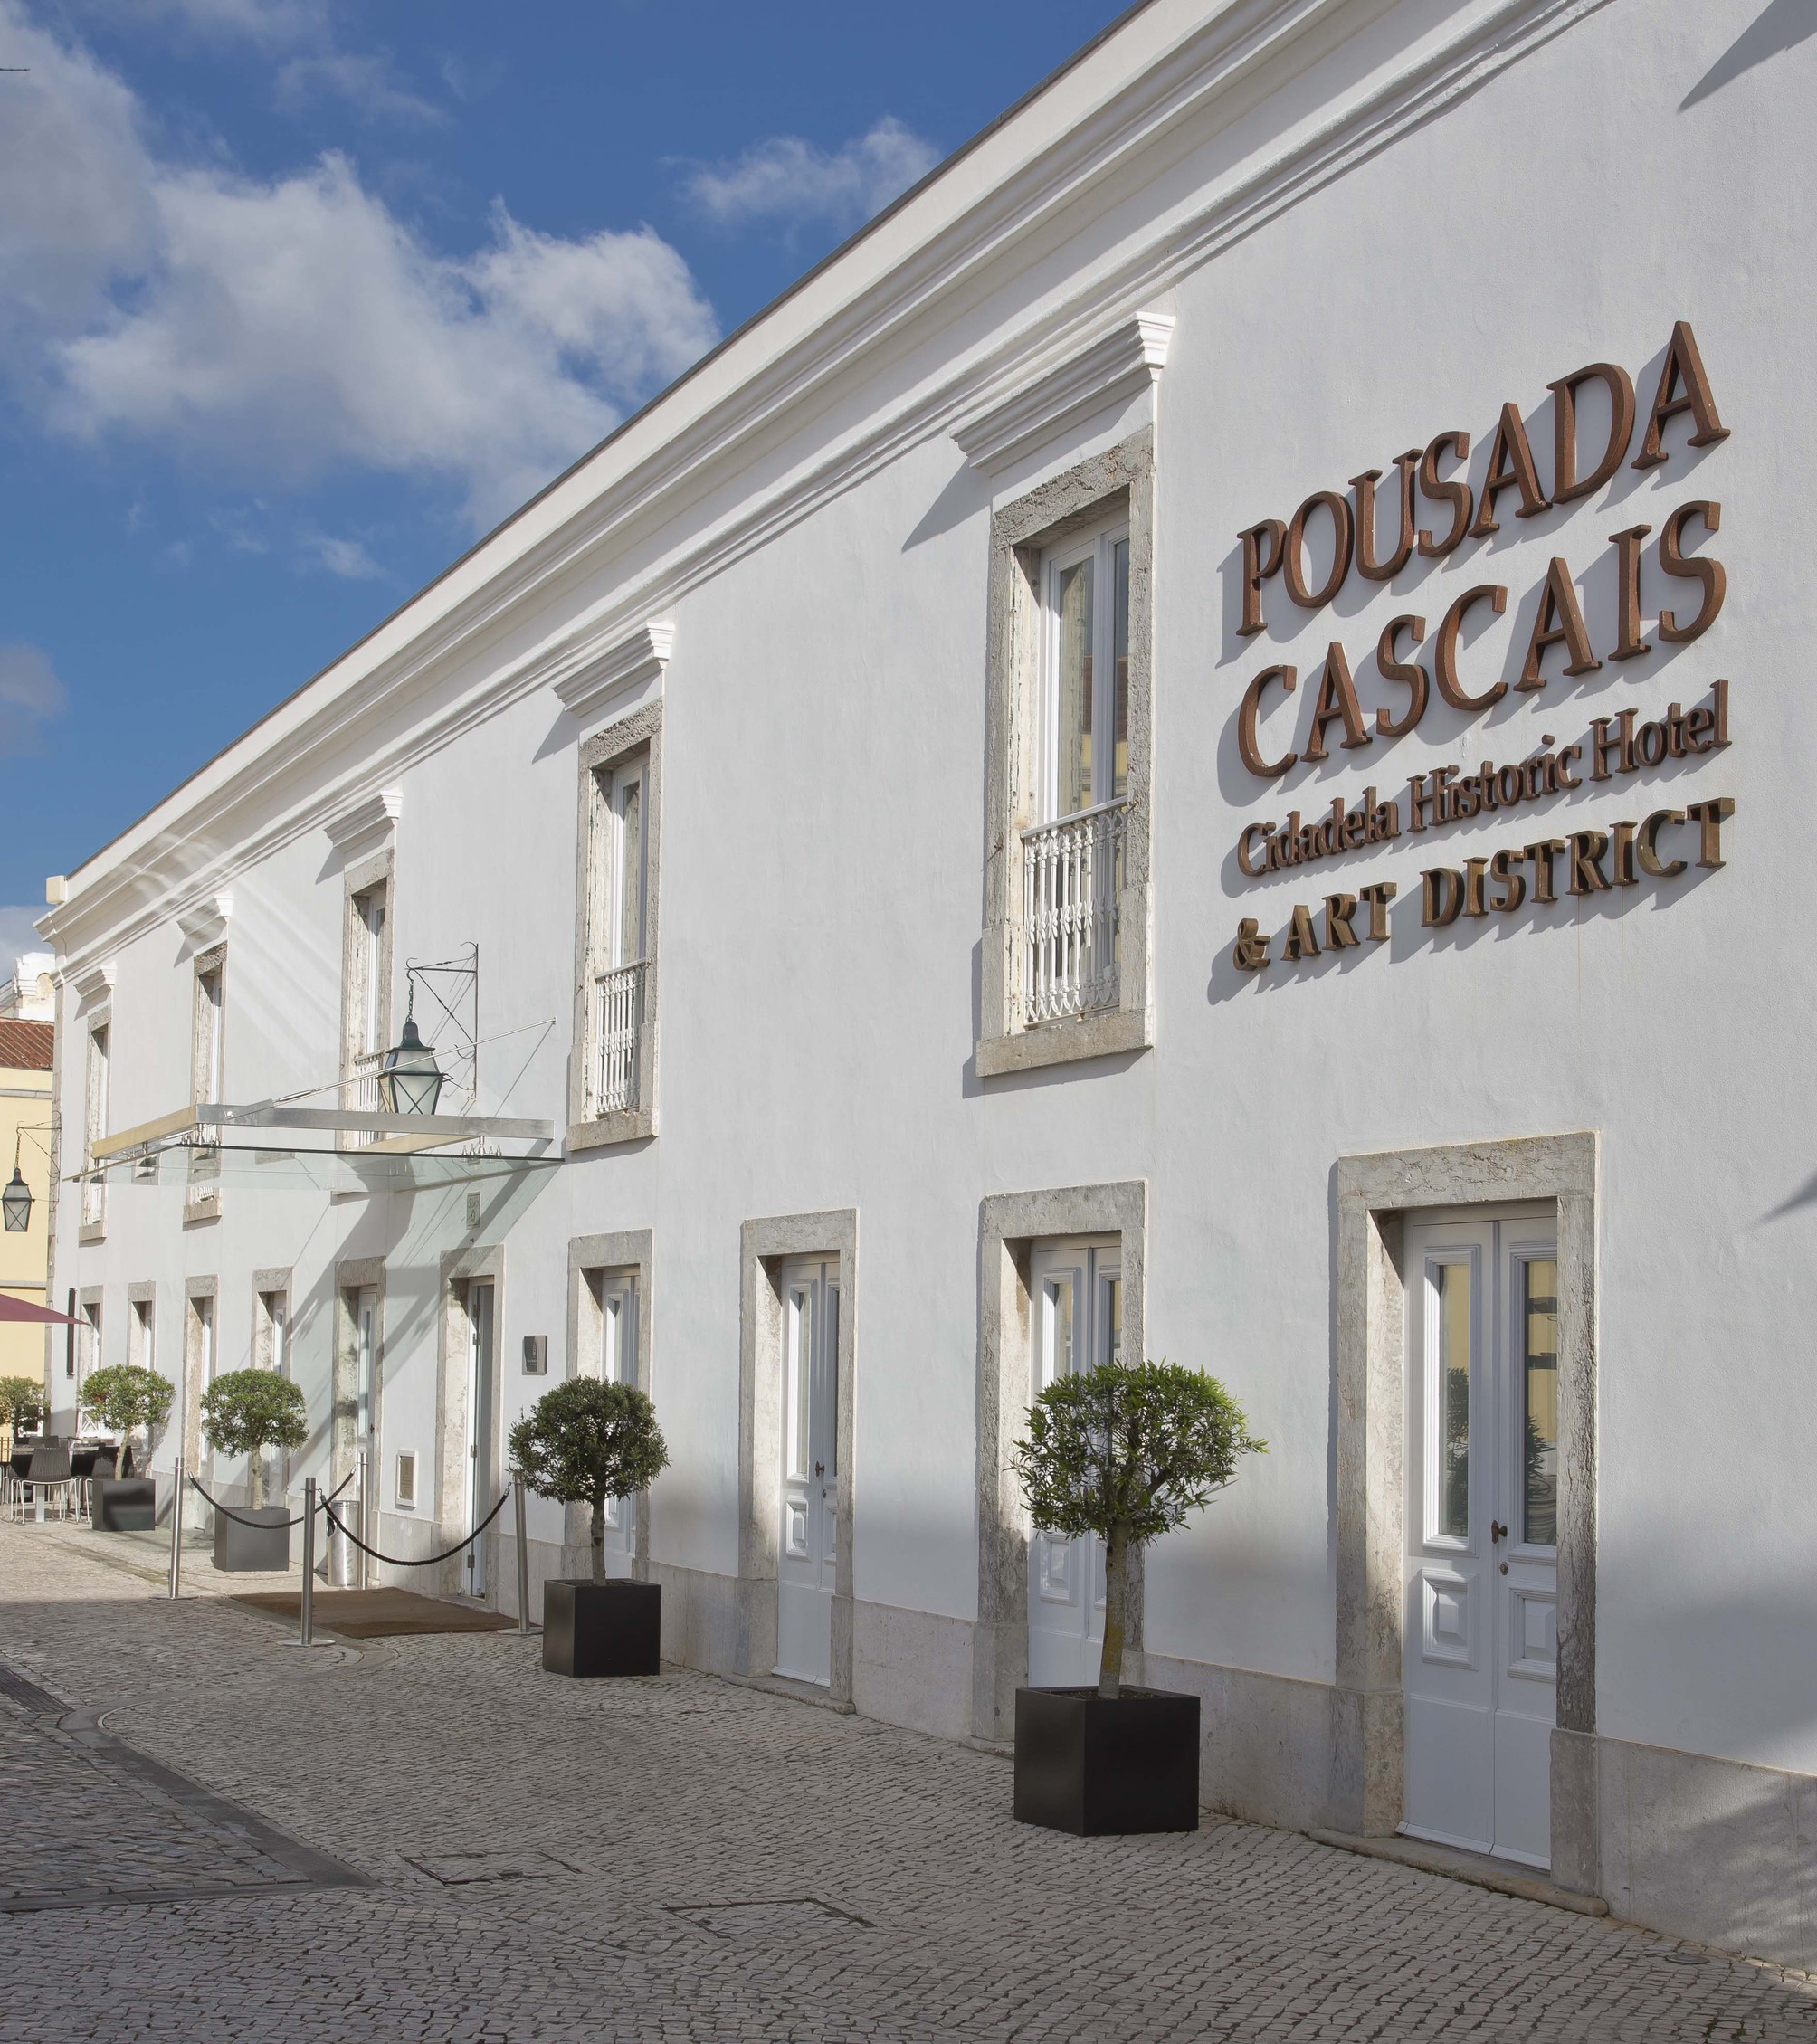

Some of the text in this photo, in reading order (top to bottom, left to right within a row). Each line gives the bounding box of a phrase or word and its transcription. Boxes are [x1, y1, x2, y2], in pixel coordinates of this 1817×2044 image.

[1236, 320, 1731, 637] POUSADA
[1237, 499, 1727, 778] CASCAIS
[1232, 796, 1736, 972] & ART DISTRICT
[1237, 678, 1733, 877] Cidadela Historic Hotel
